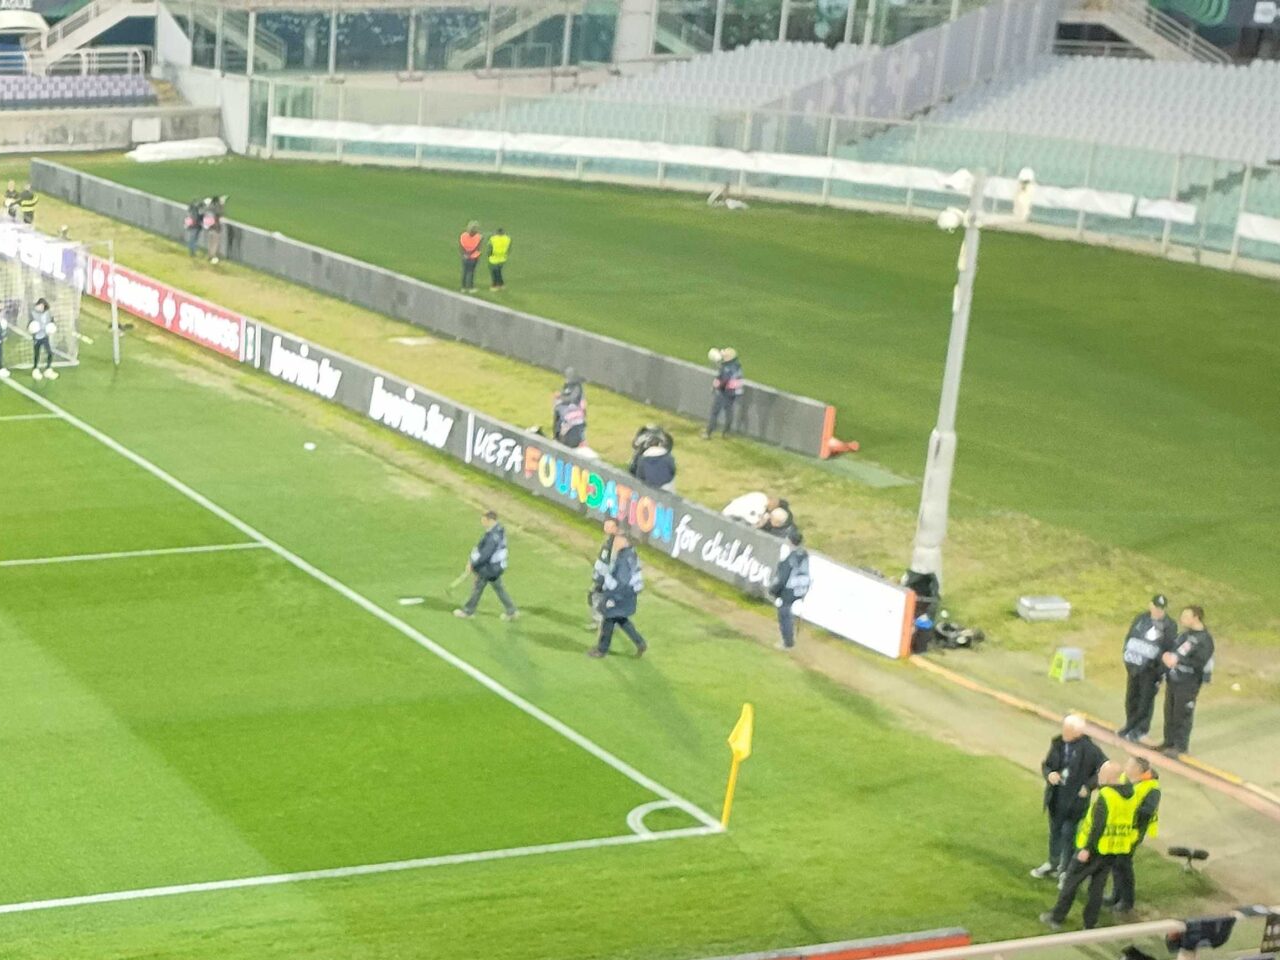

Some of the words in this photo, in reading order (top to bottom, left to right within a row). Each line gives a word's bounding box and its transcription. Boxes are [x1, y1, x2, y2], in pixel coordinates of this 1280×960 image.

[474, 427, 523, 472] UEFA
[524, 445, 674, 544] FOUNDATION
[671, 513, 705, 558] for
[701, 531, 773, 588] children
